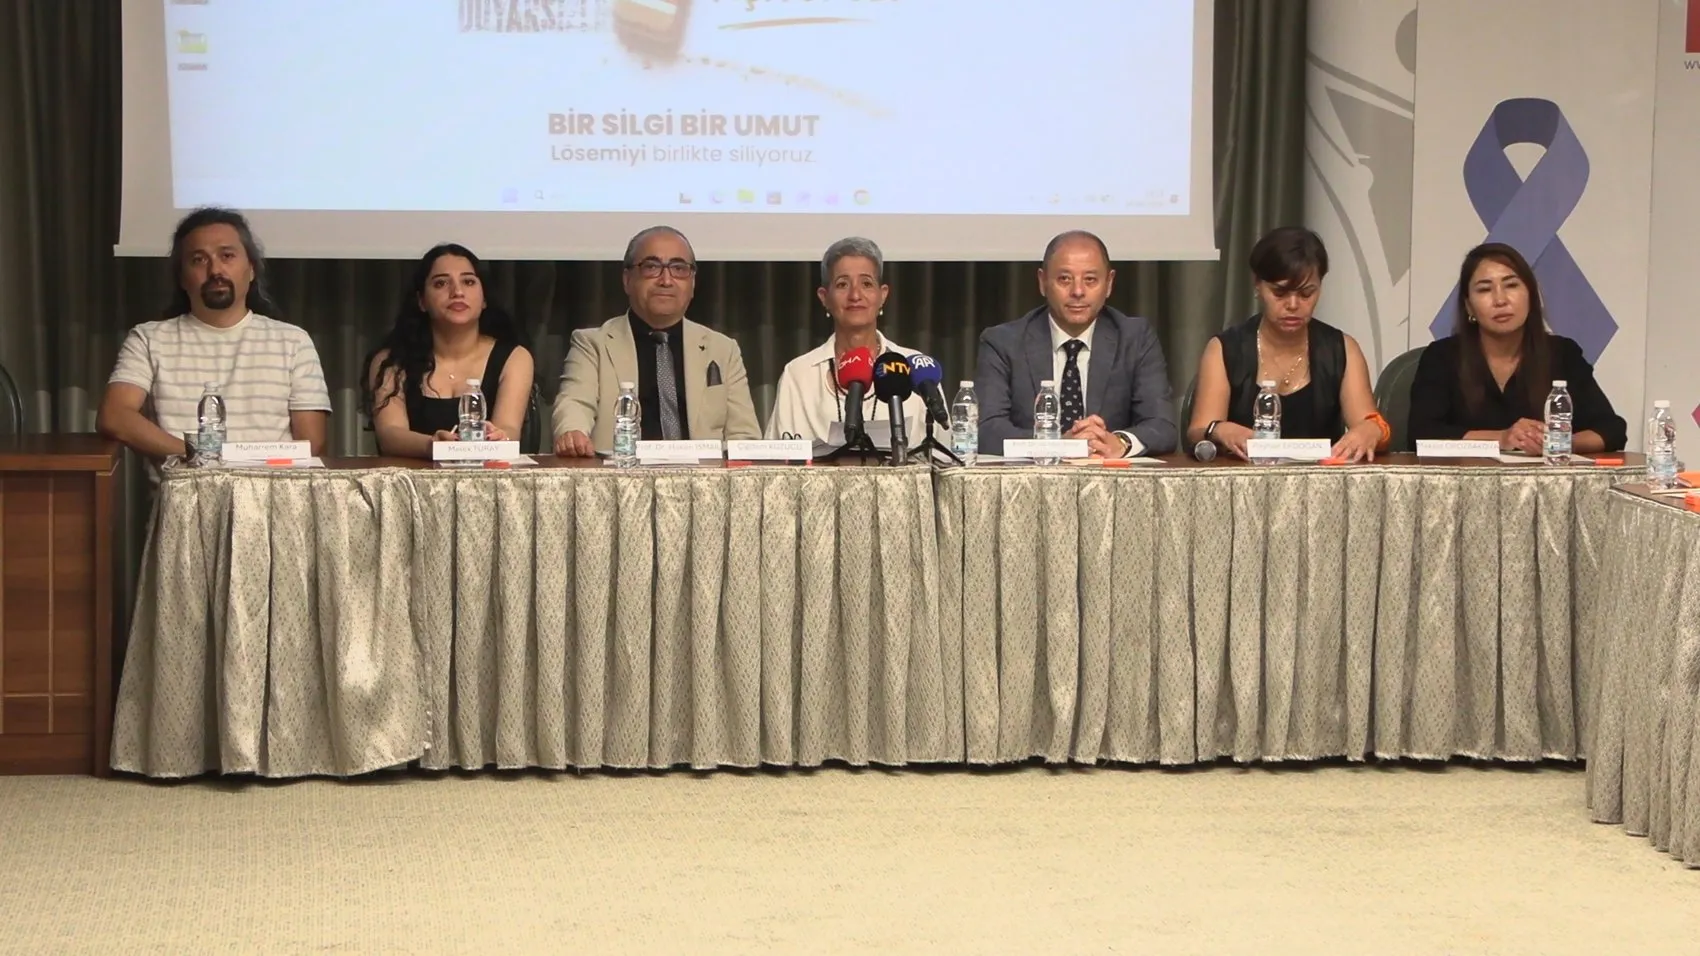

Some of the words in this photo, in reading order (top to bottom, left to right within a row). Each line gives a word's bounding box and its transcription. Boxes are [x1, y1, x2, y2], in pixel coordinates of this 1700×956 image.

[548, 108, 596, 135] BİR
[602, 108, 673, 135] SİLGİ
[680, 108, 727, 135] BİR
[734, 114, 820, 136] UMUT
[551, 144, 647, 167] Lösemiyi
[653, 144, 722, 163] birlikte
[882, 361, 912, 376] NTV
[912, 355, 936, 370] AA
[235, 443, 278, 451] Muharrem
[279, 443, 298, 451] Kara
